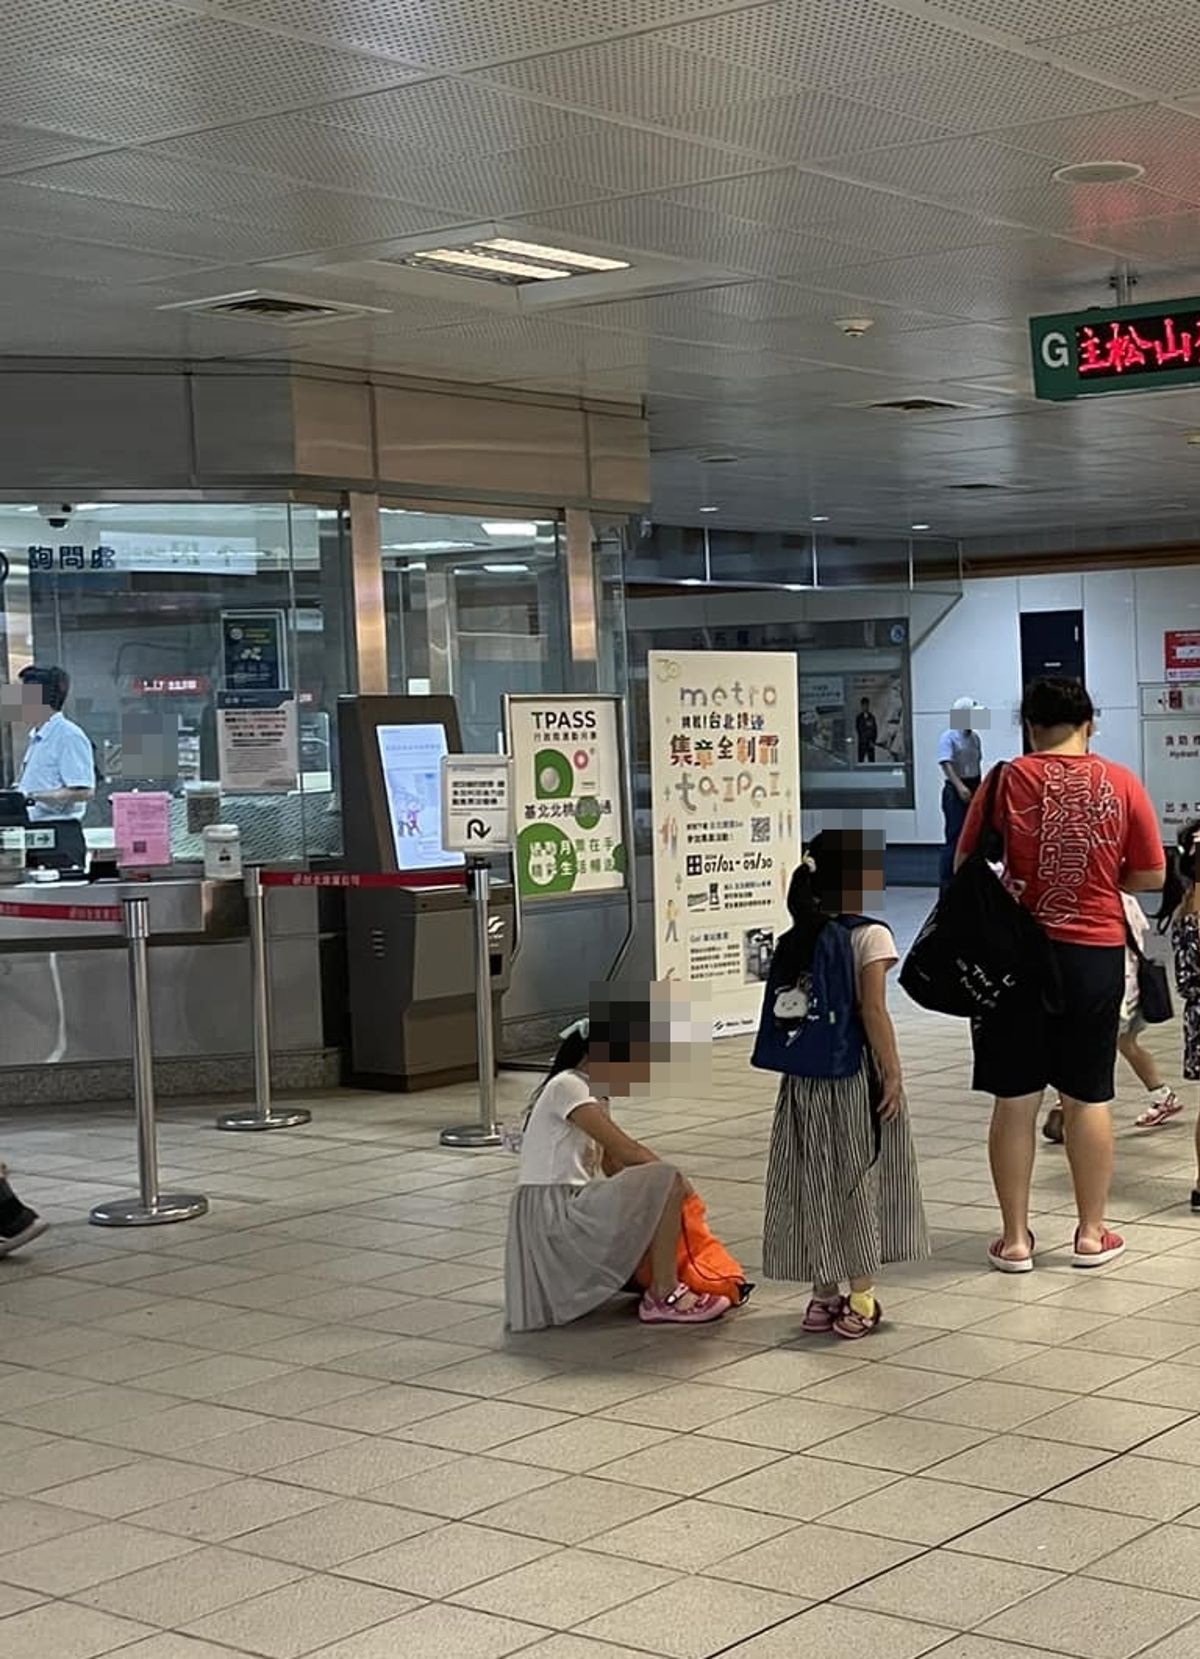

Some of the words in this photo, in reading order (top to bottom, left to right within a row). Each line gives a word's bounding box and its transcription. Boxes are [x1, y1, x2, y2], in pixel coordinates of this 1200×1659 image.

[1041, 332, 1069, 368] G
[680, 681, 777, 707] metro
[531, 710, 596, 729] TPASS
